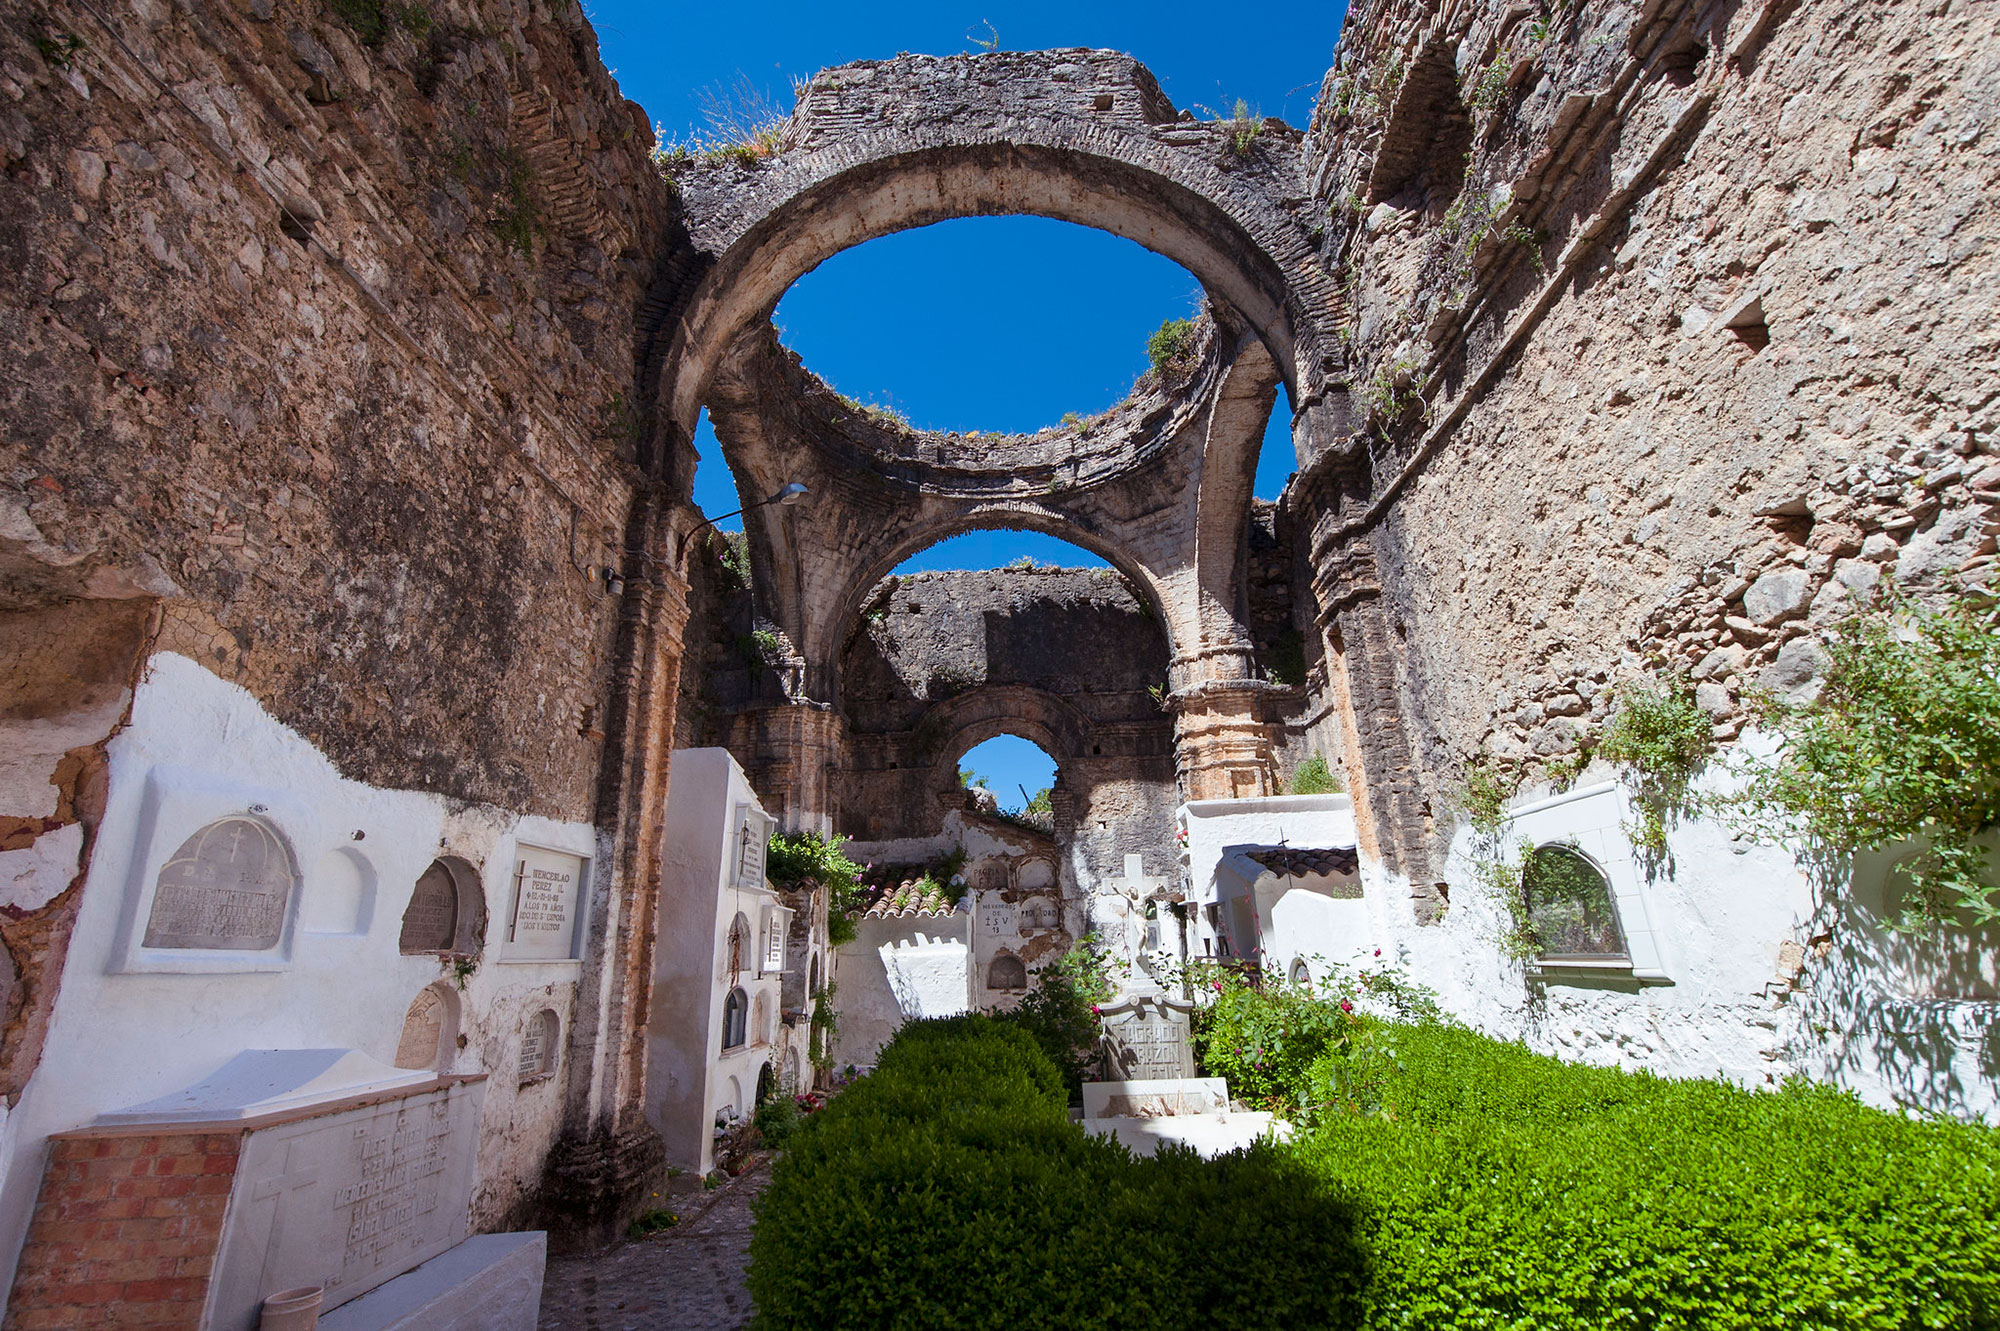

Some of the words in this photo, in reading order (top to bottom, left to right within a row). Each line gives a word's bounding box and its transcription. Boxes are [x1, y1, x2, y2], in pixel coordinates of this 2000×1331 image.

[532, 869, 570, 884] WENCESLAO
[531, 880, 552, 892] PEREZ
[550, 903, 564, 912] AÑOS
[1127, 1044, 1181, 1064] RAZON
